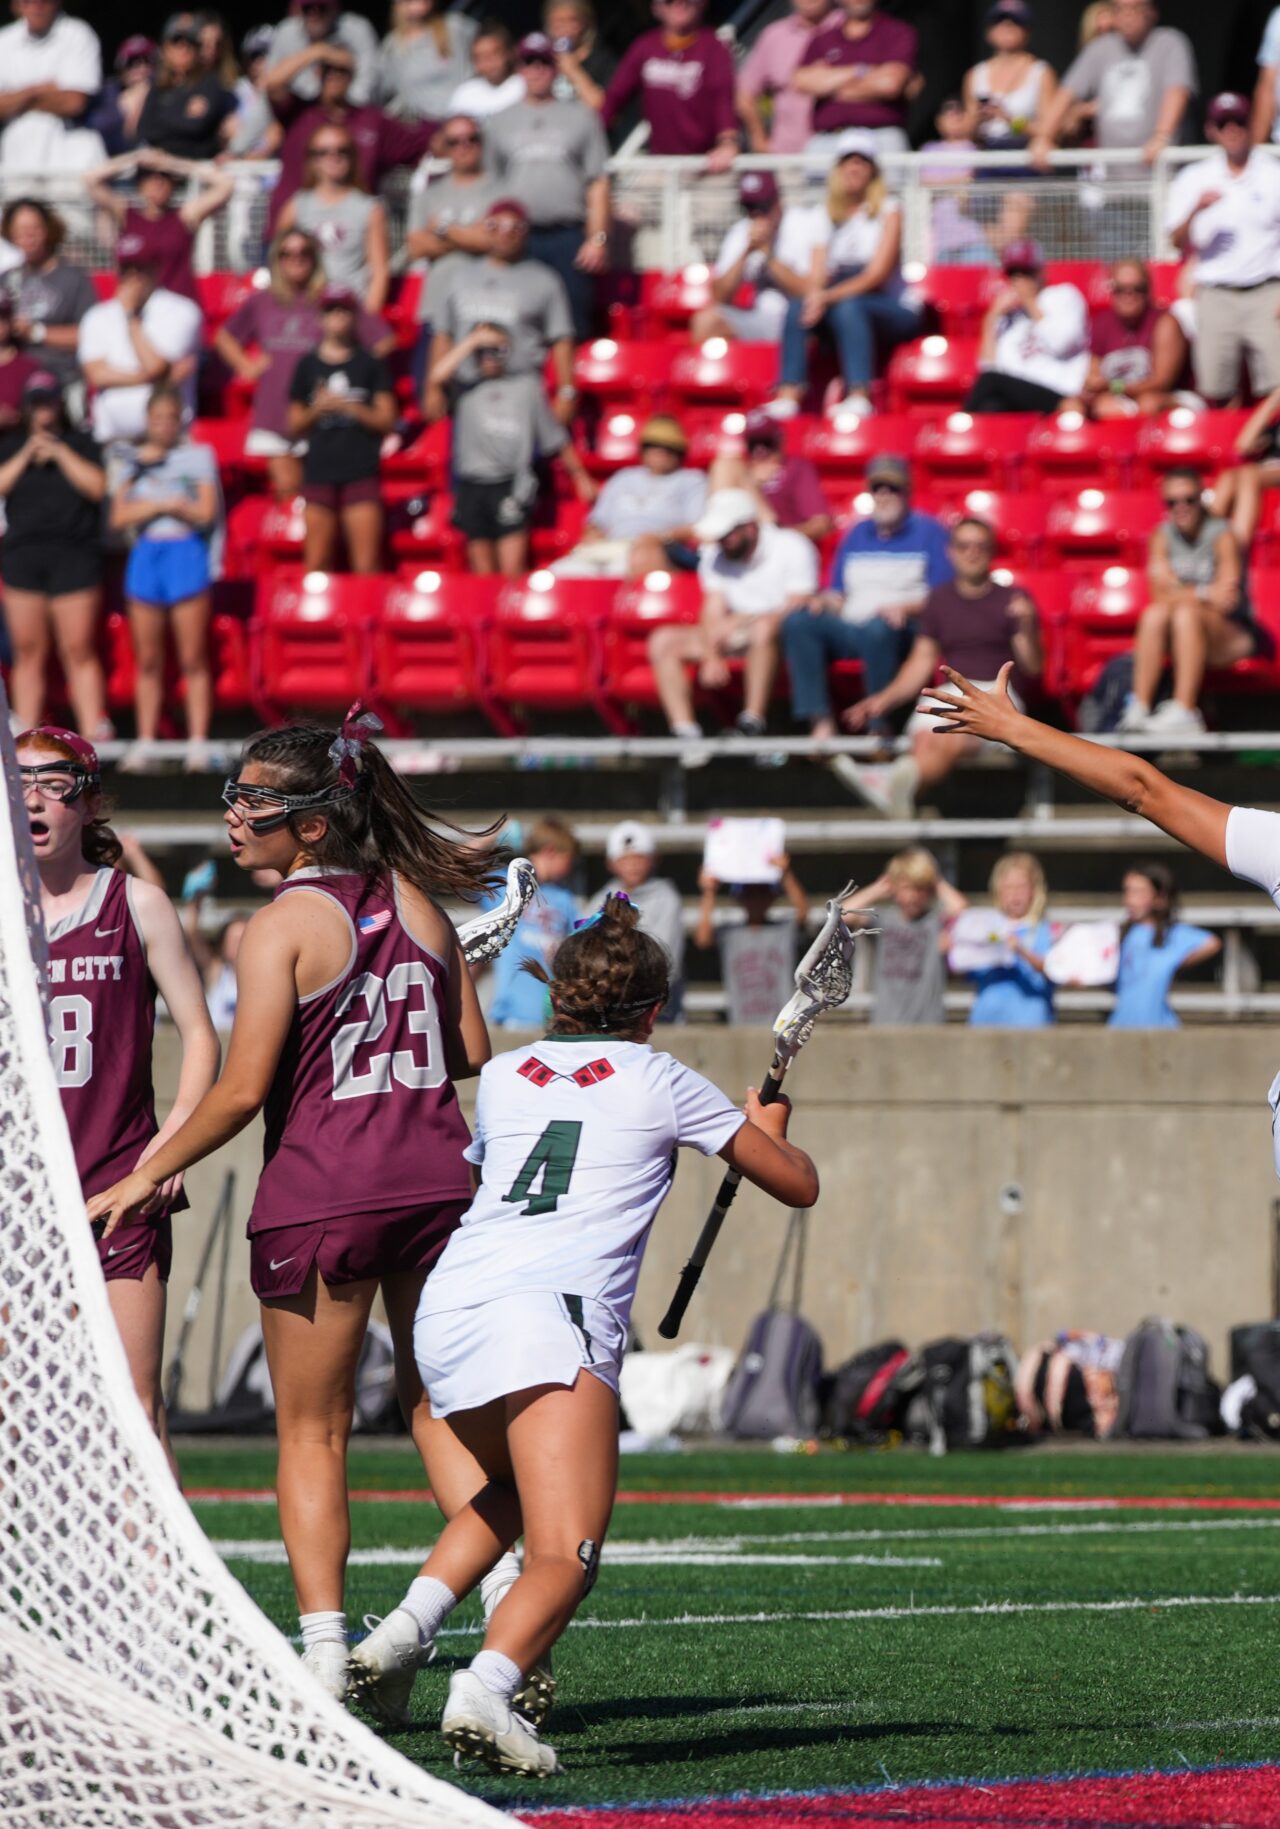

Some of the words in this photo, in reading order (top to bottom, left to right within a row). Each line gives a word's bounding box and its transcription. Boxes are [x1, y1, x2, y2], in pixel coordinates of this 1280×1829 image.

[72, 955, 124, 982] CITY
[48, 993, 93, 1088] 8
[330, 961, 448, 1101] 23
[501, 1119, 584, 1217] 4
